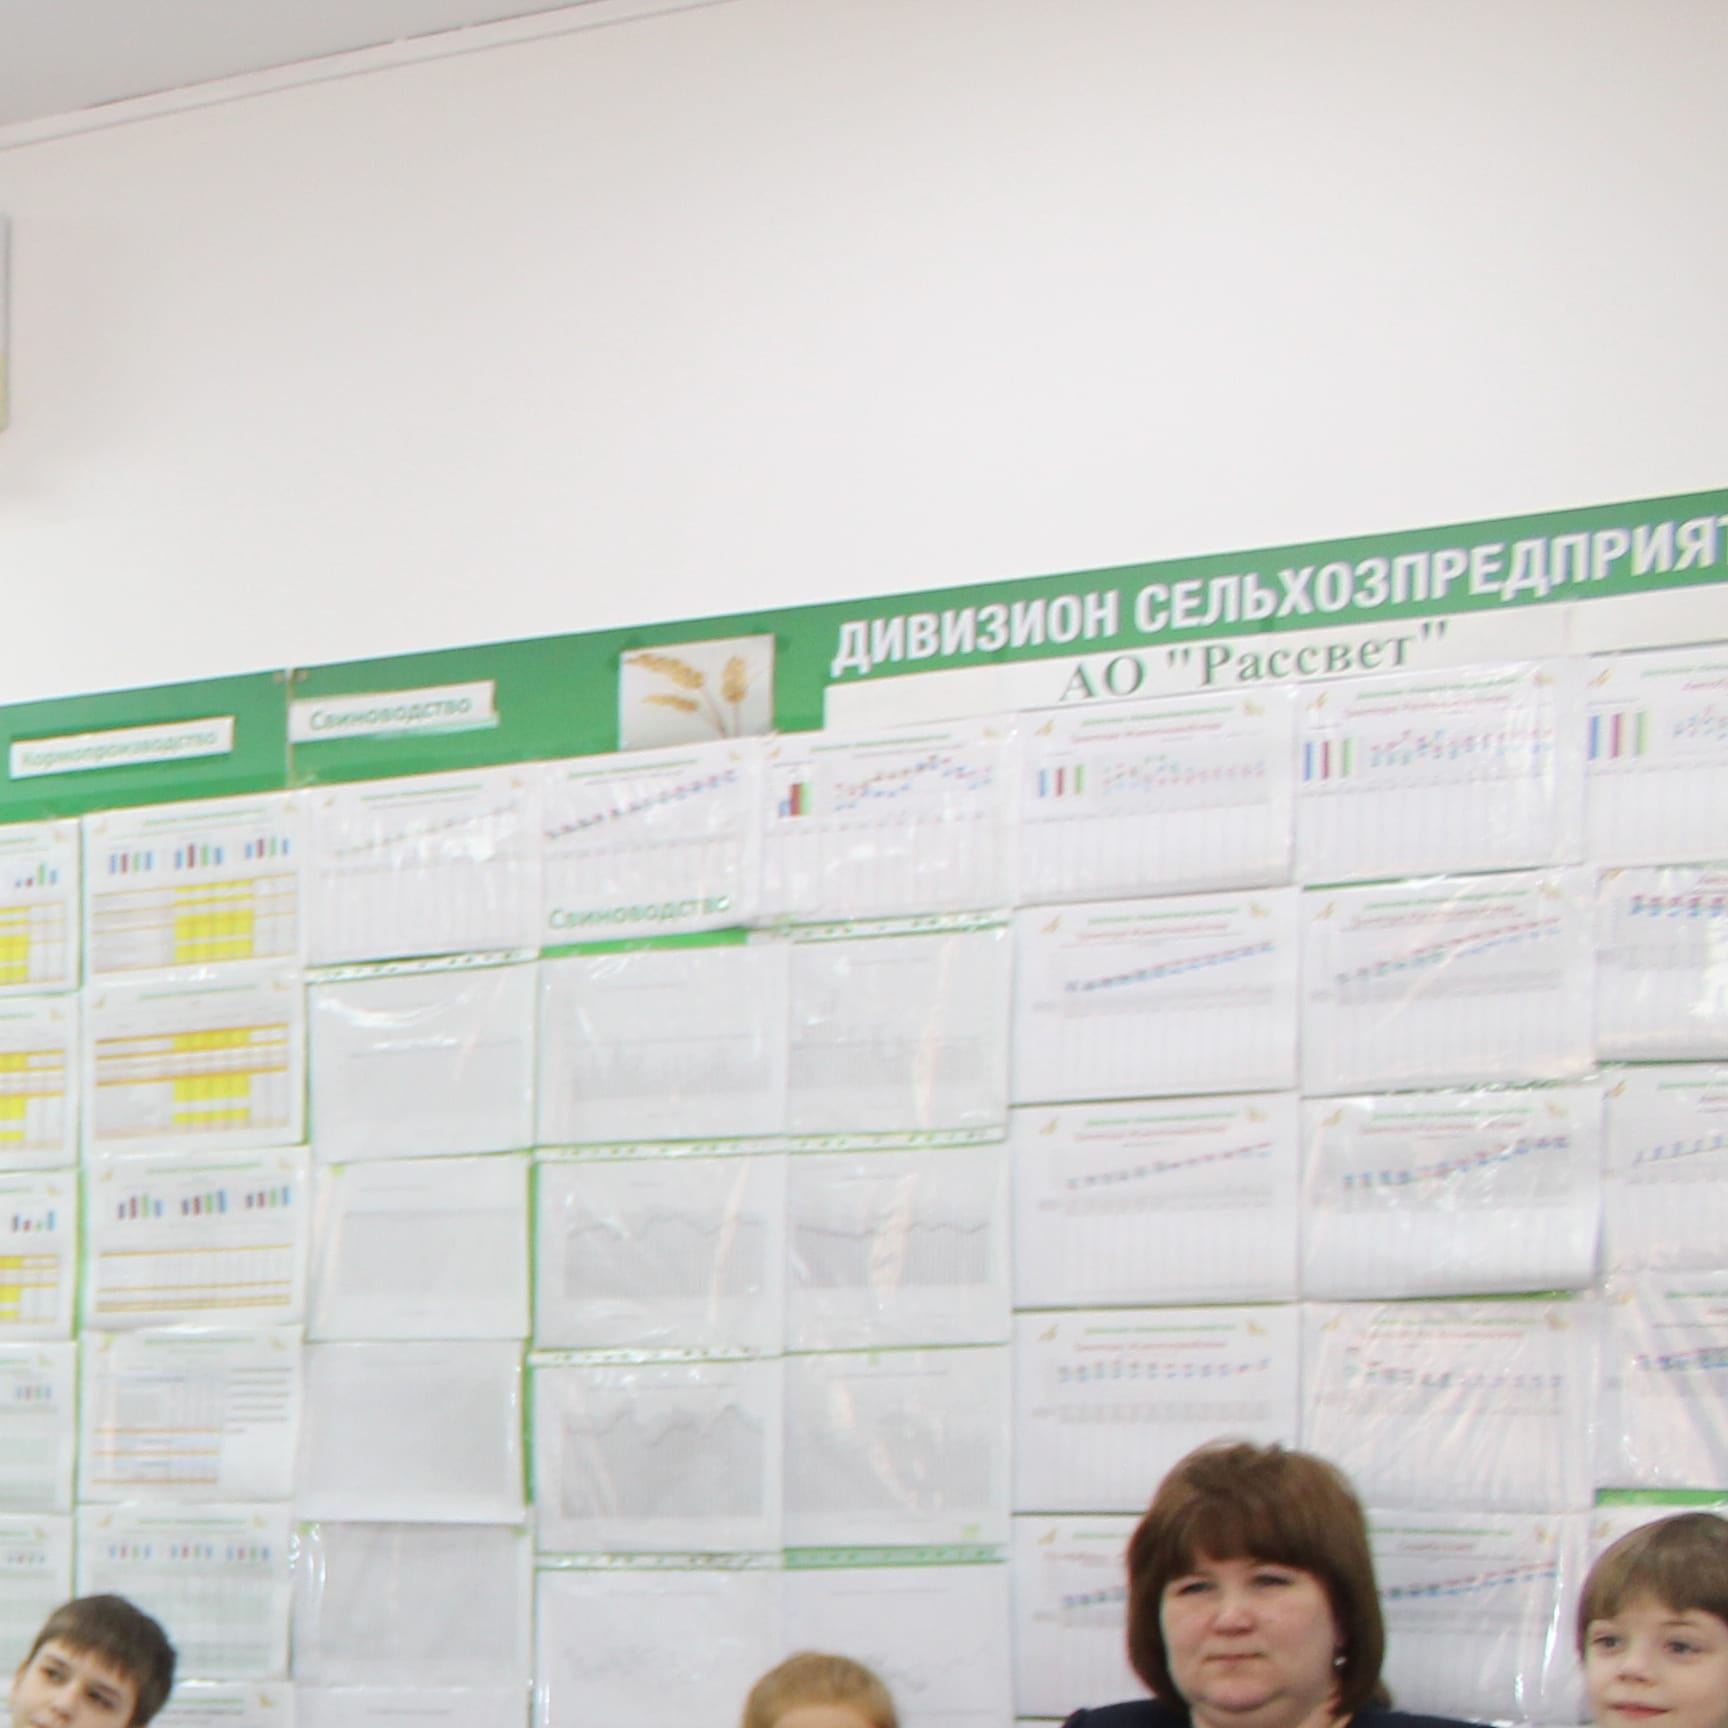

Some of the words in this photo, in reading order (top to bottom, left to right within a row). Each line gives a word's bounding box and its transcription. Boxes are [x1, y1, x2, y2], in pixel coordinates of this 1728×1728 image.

[831, 589, 1119, 677] ДИВИЗИОН
[1058, 656, 1146, 703] АО
[1168, 620, 1451, 689] "Рассвет"
[310, 695, 473, 731] Свиноводство
[548, 894, 733, 930] Свиноводство
